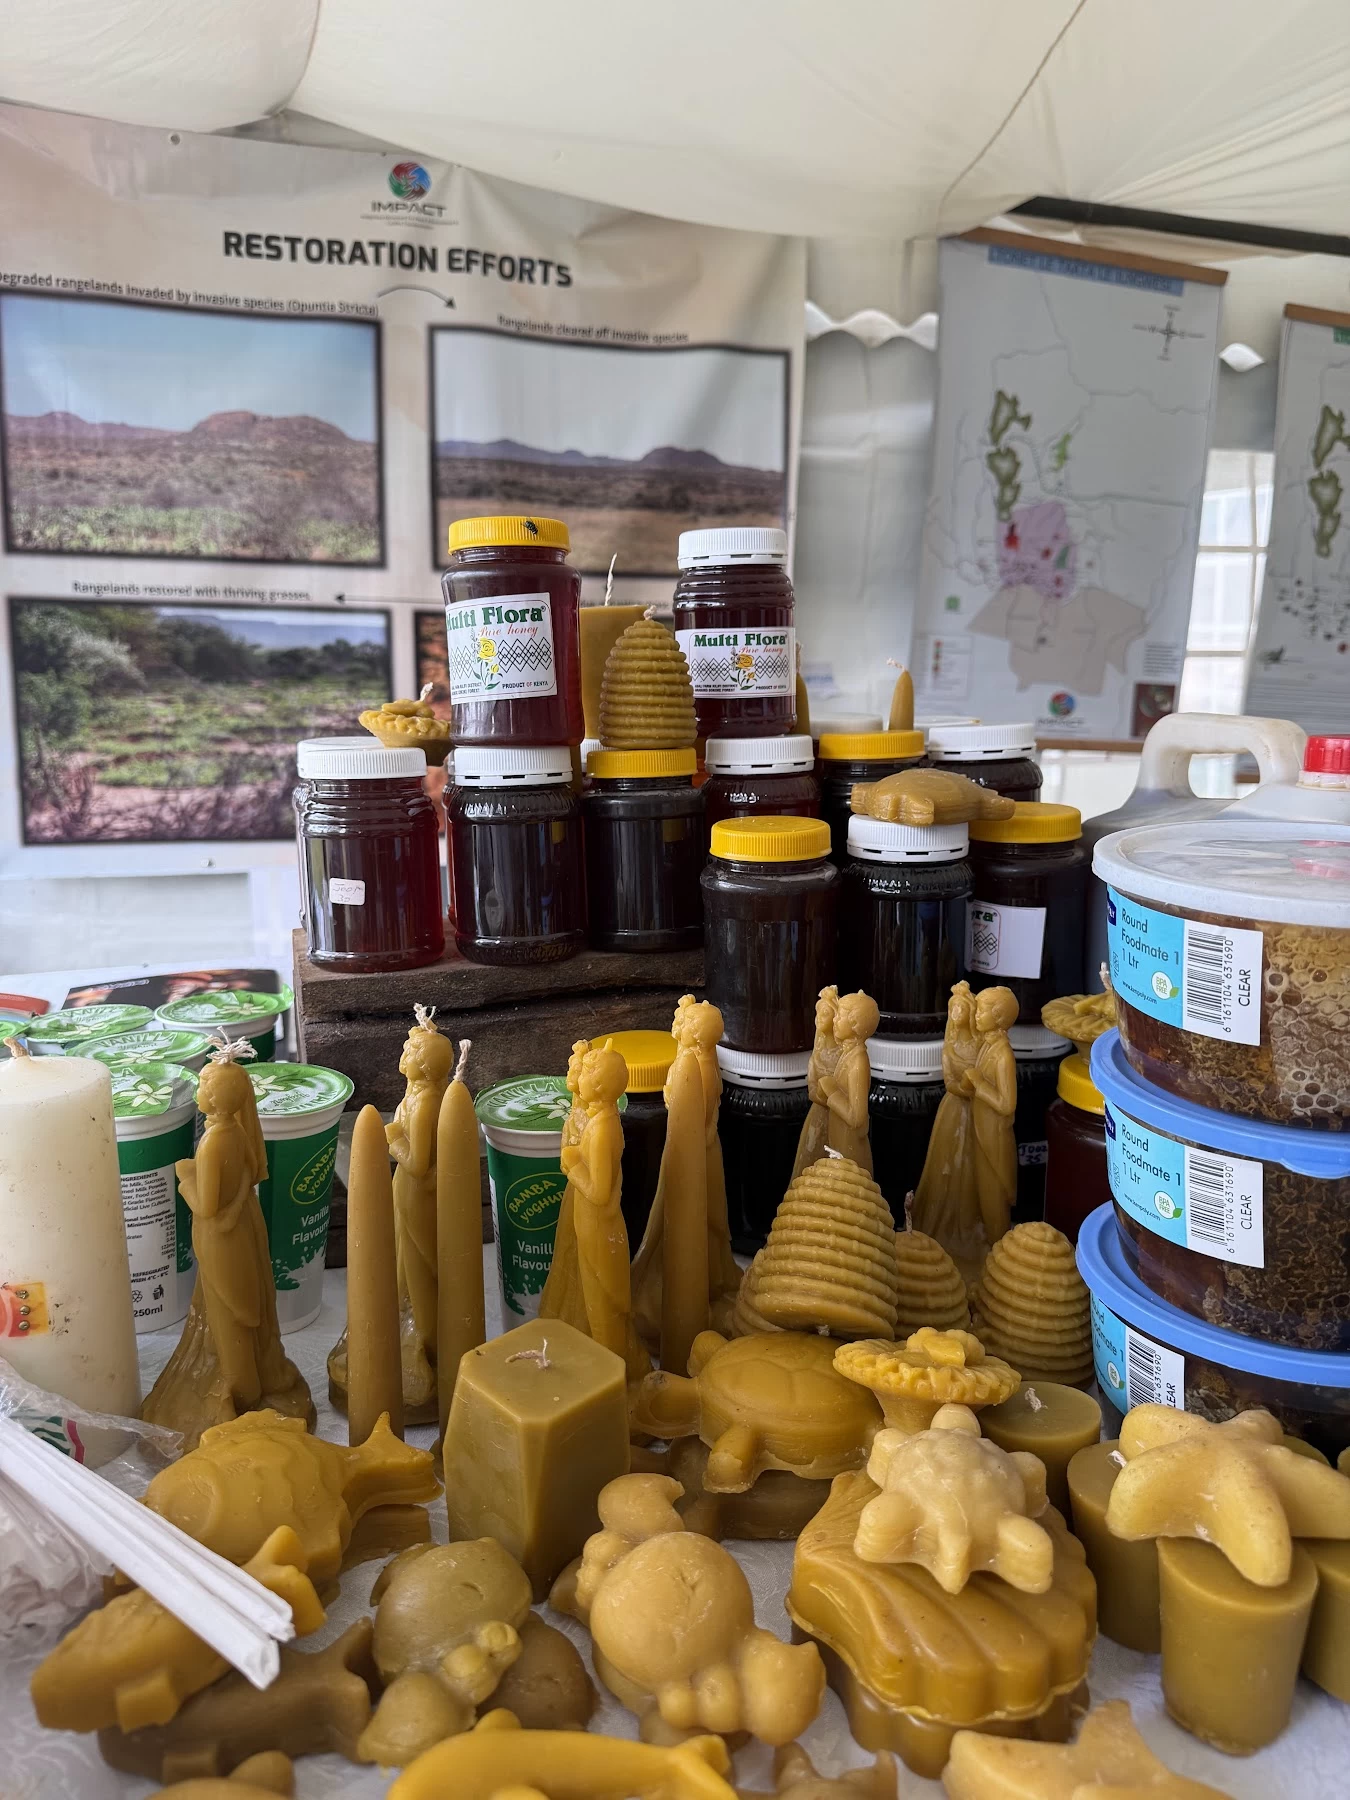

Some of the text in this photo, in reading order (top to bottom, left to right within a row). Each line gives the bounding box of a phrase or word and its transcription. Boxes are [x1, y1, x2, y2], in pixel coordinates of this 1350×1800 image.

[371, 201, 447, 217] IMPACT
[223, 231, 573, 287] RESTORATION EFFORTS
[56, 277, 123, 294] rangelands
[126, 283, 174, 300] invaded
[176, 290, 191, 305] by
[194, 291, 240, 308] invasive
[243, 298, 285, 311] species
[497, 313, 553, 333] Rangelands
[555, 323, 594, 338] cleared
[612, 330, 650, 343] invasive
[652, 332, 690, 344] species
[73, 582, 311, 602] Rangelands restored with thriving grasses
[478, 623, 538, 638] Pure honey
[694, 634, 738, 647] Multi
[502, 682, 525, 690] PRODUCT
[1121, 907, 1148, 934] Round
[1121, 929, 1180, 966] Foodmate 1
[1122, 947, 1140, 970] 1 Ltr
[1223, 939, 1234, 979] 631690
[1156, 975, 1168, 989] BPA
[1156, 984, 1169, 996] FREE
[1238, 968, 1251, 1007] CLEAR
[1223, 984, 1233, 1021] 161104
[487, 1082, 560, 1108] VANILLA
[1121, 1123, 1149, 1152] Round
[121, 1171, 158, 1182] NGREDIENTS
[296, 1146, 335, 1192] BAMBA
[1121, 1142, 1181, 1187] Foodmate 1
[1123, 1162, 1141, 1186] 1 Ltr
[135, 1191, 150, 1199] Food
[508, 1179, 558, 1213] BAMBA
[1224, 1165, 1235, 1204] 631690
[1158, 1194, 1170, 1208] BPA
[1158, 1202, 1172, 1216] FREE
[1240, 1194, 1253, 1230] CLEAR
[127, 1220, 154, 1228] Minimum
[1225, 1207, 1235, 1243] 161104
[516, 1239, 554, 1255] Vanill
[512, 1254, 552, 1271] Flavou
[133, 1303, 163, 1318] 250ml
[1119, 1348, 1124, 1363] 1
[1154, 1353, 1162, 1389] 631690
[1166, 1382, 1176, 1408] LEAR
